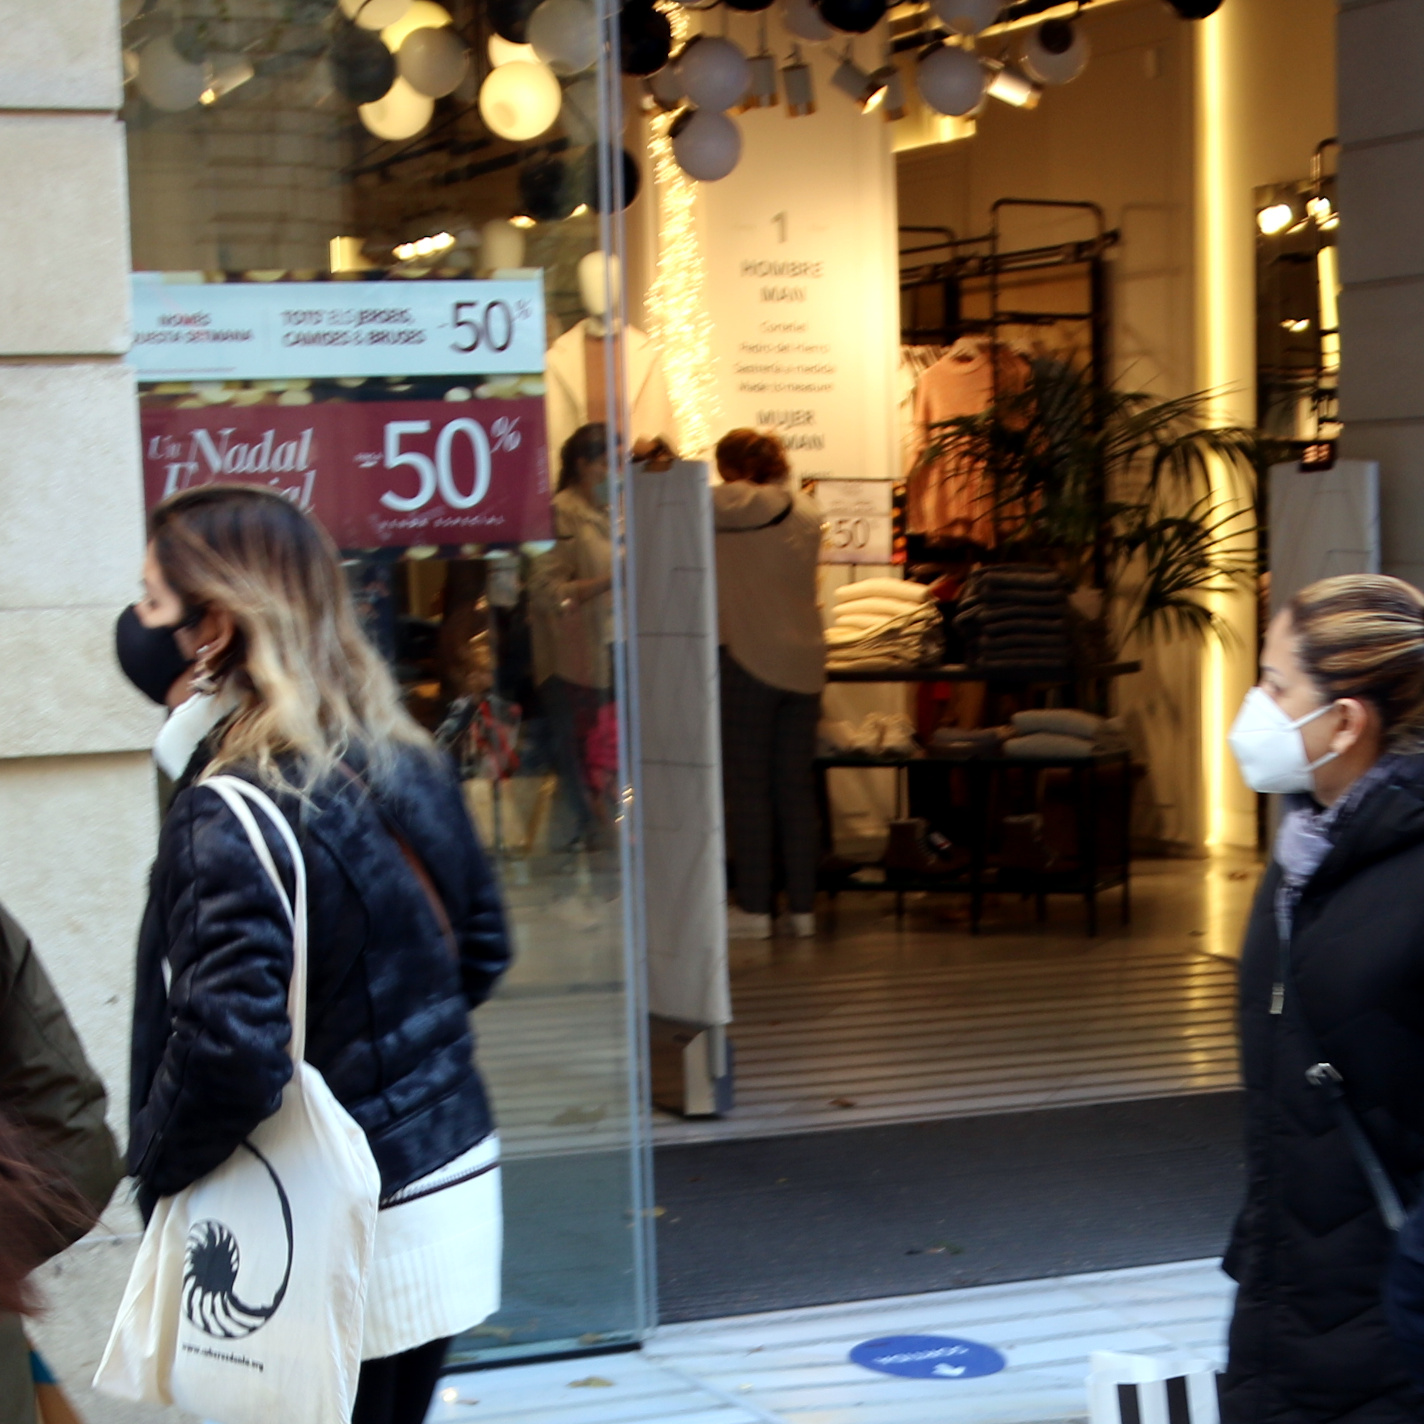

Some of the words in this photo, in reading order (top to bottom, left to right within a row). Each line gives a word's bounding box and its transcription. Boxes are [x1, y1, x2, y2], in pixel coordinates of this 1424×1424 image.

[740, 260, 824, 278] HOMBRE
[760, 286, 807, 302] MAN
[756, 409, 815, 428] MUJER
[187, 426, 315, 475] Nadal
